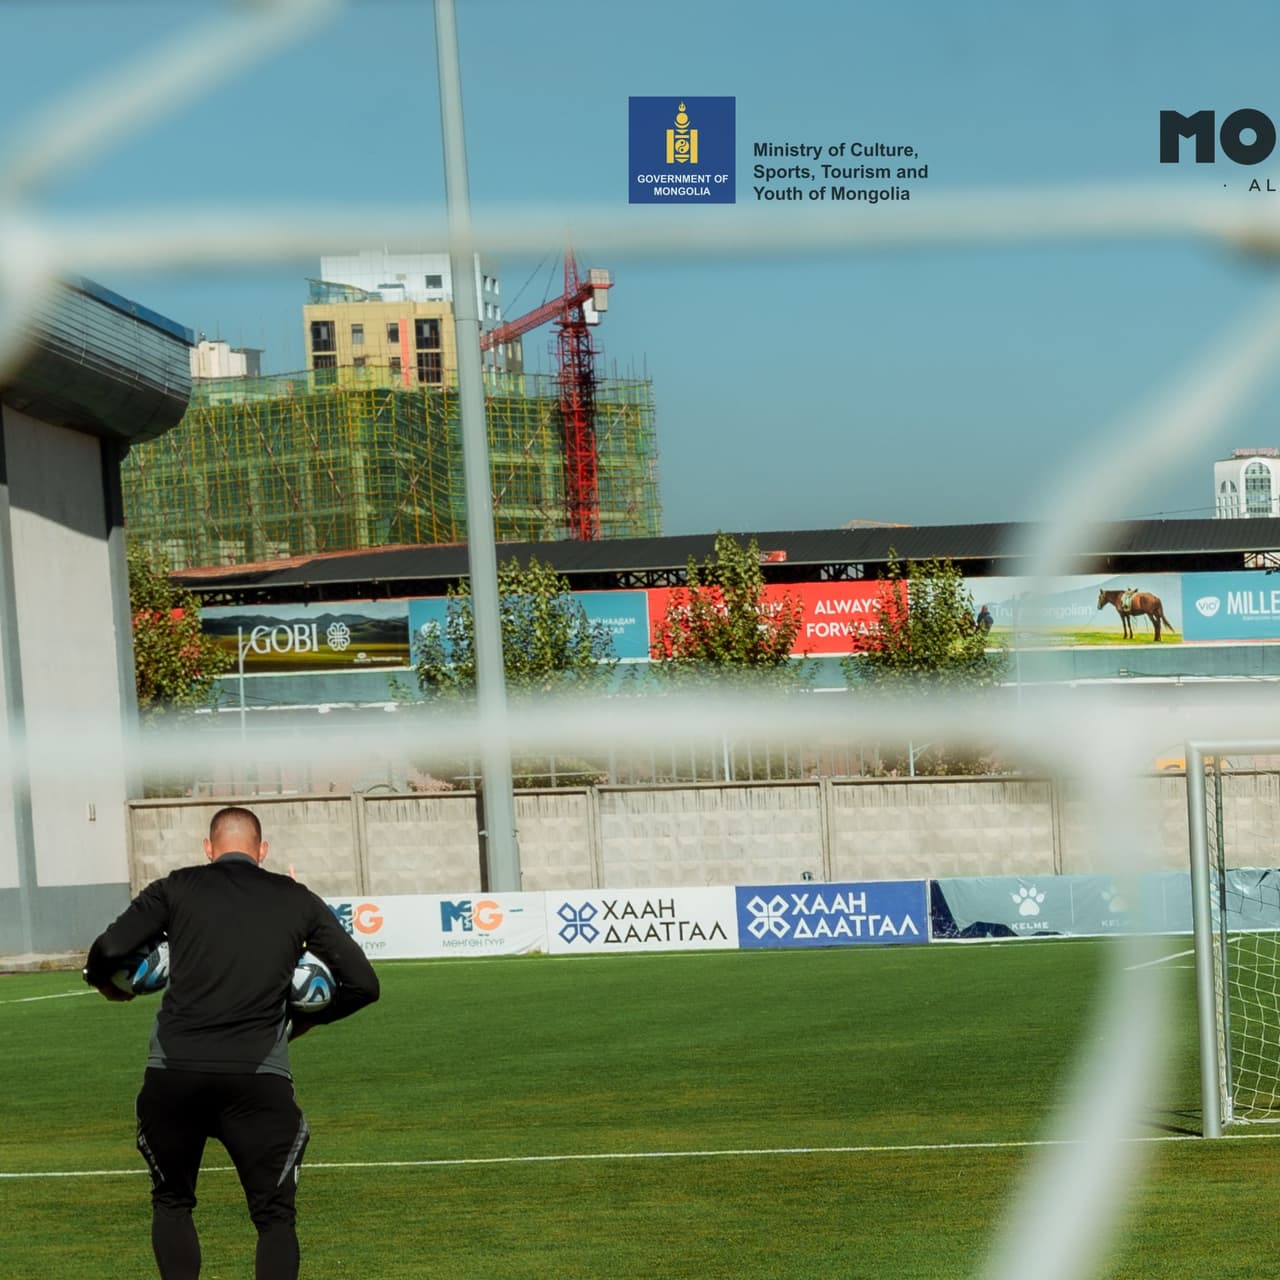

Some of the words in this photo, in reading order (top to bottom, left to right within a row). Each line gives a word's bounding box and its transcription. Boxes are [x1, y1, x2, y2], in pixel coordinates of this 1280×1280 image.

[814, 599, 881, 615] ALWAYS
[251, 623, 319, 654] GOBI
[1011, 922, 1049, 930] KELME
